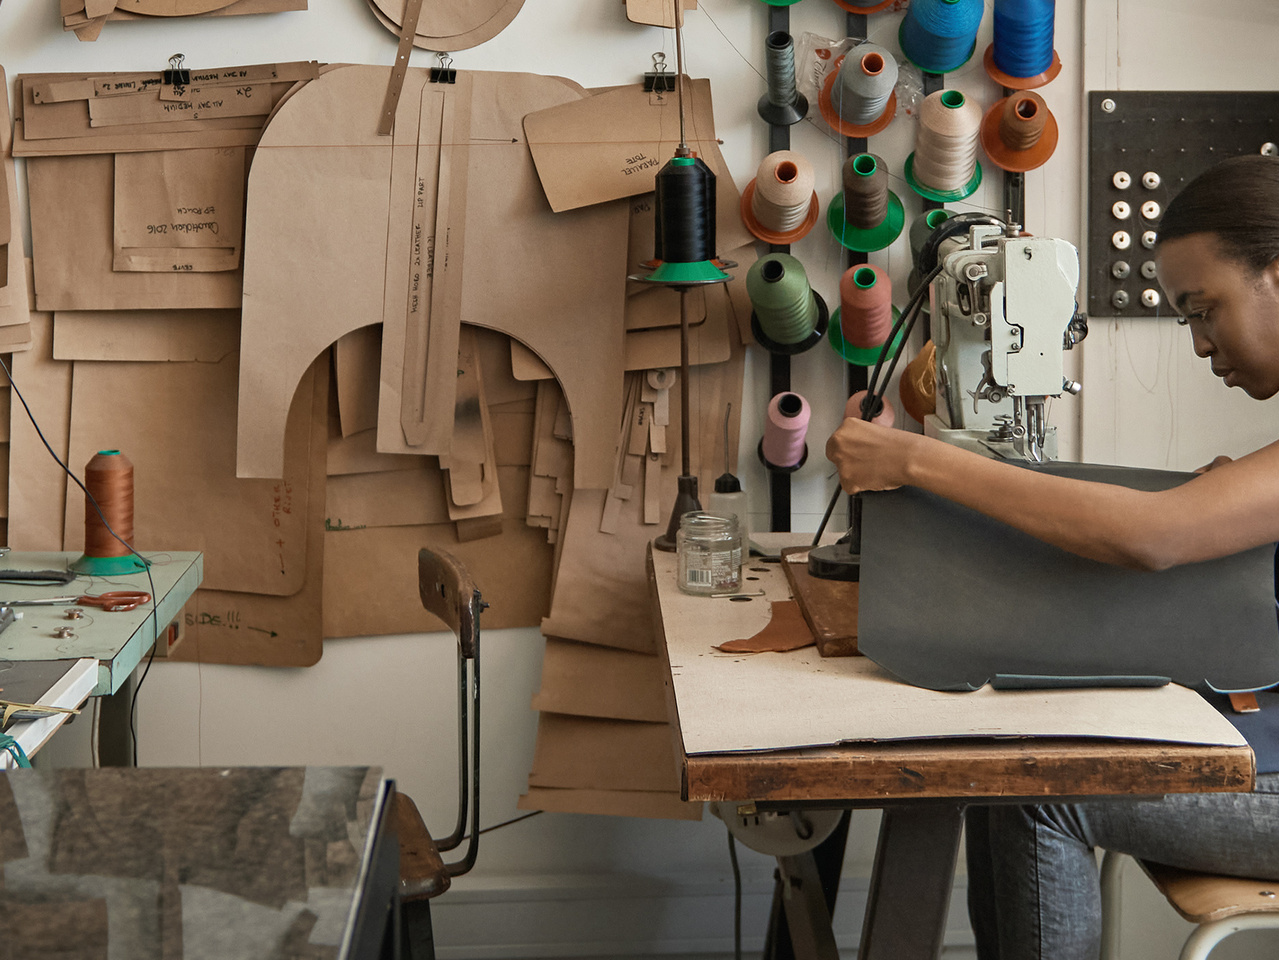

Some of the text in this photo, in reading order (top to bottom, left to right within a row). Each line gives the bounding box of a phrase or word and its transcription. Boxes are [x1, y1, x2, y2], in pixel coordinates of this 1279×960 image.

[626, 153, 646, 164] TOTE
[621, 158, 659, 175] PARALLEL
[147, 224, 167, 235] 2016
